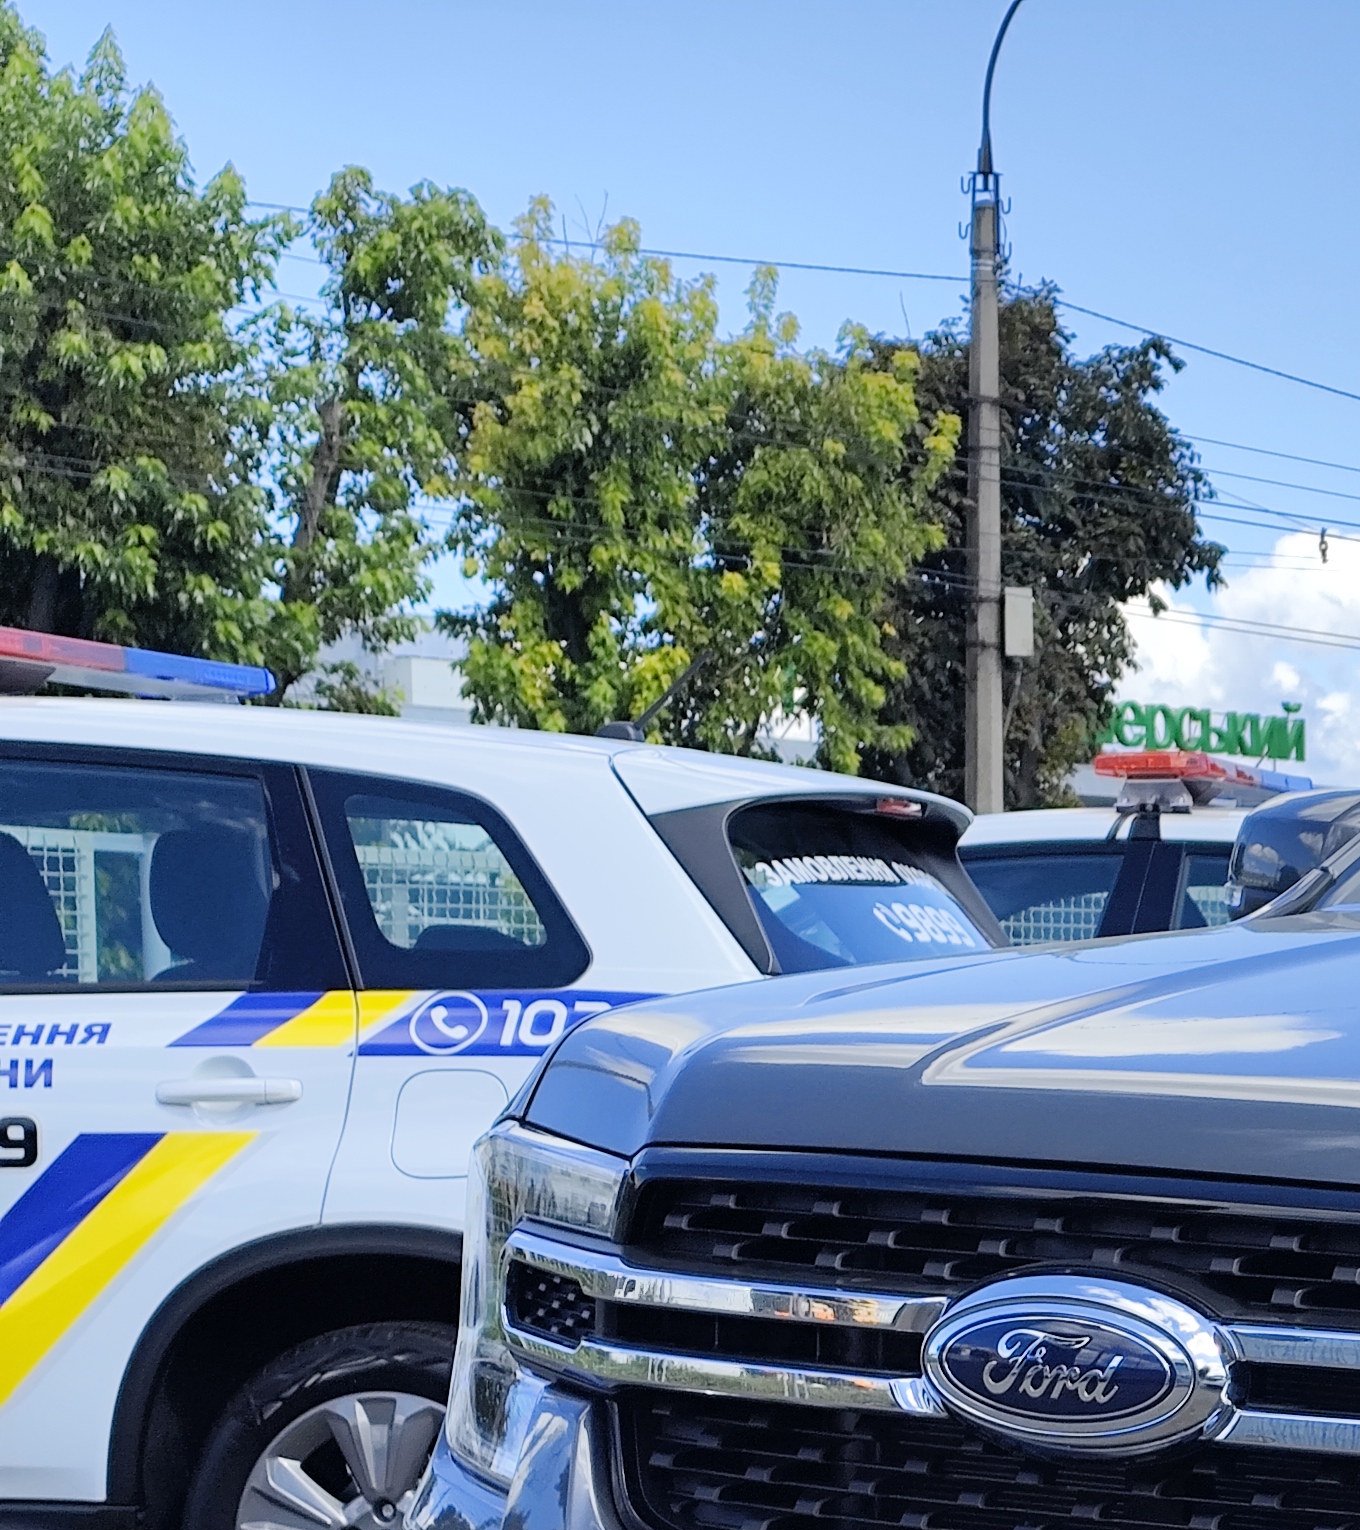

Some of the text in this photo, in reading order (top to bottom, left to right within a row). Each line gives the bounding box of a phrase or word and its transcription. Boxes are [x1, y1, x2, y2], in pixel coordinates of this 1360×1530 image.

[755, 856, 901, 888] ЗАМОВЛЕННЯ
[891, 902, 976, 948] 9899
[500, 999, 611, 1047] 10
[983, 1328, 1124, 1404] Ford
